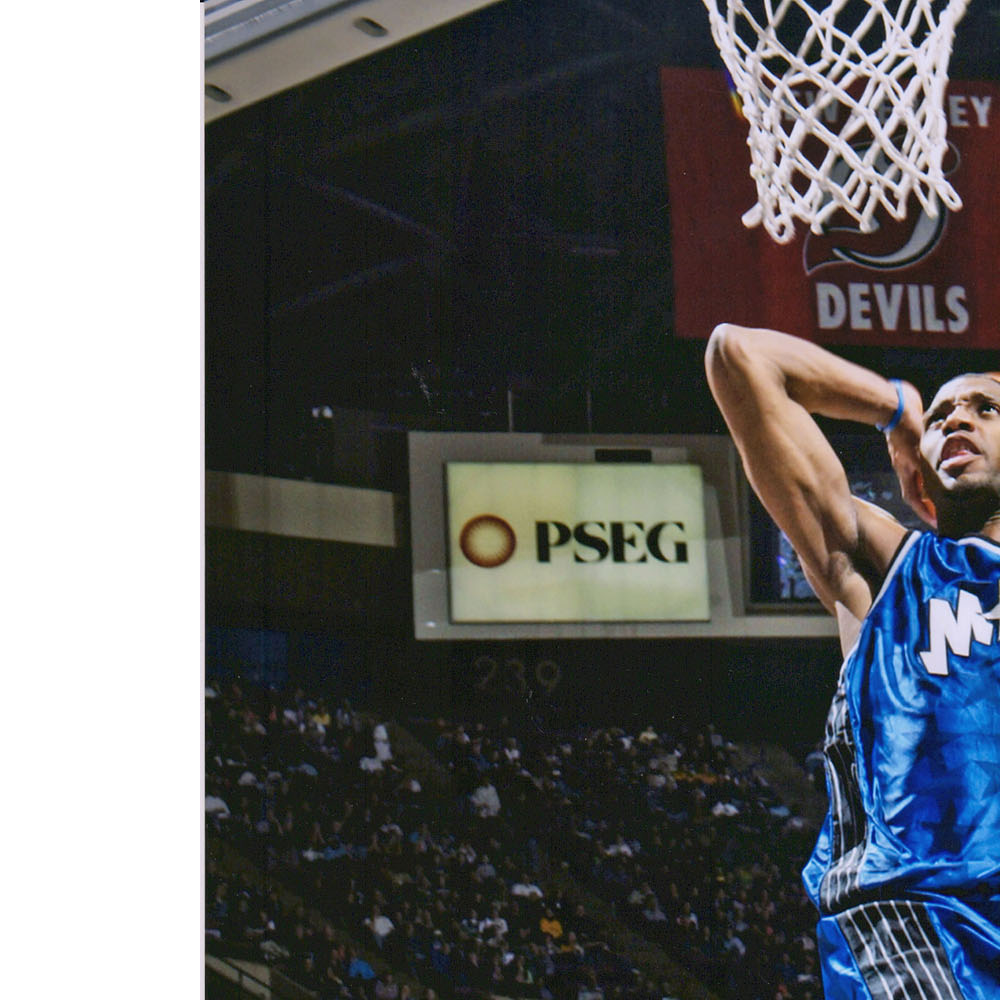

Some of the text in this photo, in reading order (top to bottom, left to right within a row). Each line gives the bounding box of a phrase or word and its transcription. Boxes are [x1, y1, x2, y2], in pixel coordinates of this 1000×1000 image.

[816, 282, 969, 332] DEVILS
[535, 521, 689, 563] PSEG
[473, 656, 561, 695] 239
